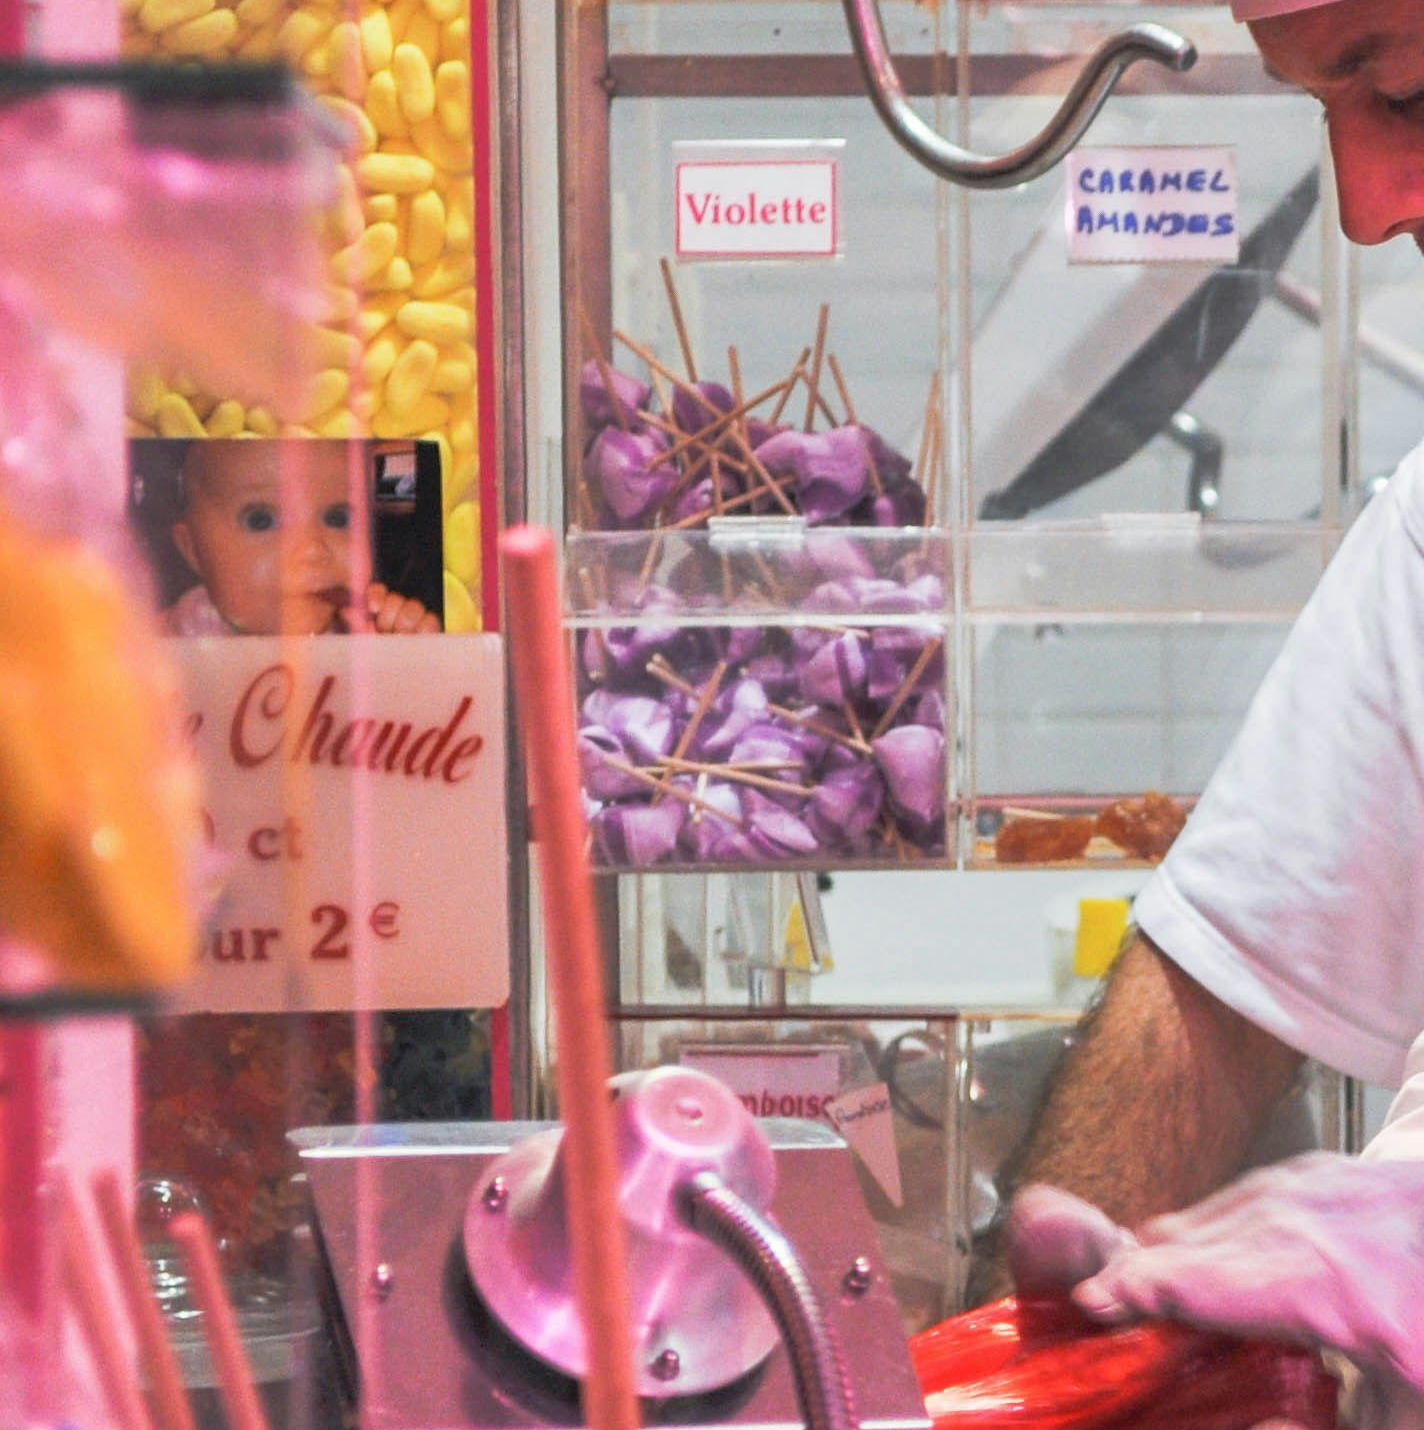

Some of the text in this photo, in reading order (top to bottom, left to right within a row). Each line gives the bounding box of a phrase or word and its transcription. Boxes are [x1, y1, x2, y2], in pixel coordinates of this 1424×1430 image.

[1079, 168, 1230, 193] CARAMEL
[686, 192, 826, 225] Violette
[1077, 205, 1234, 236] AMANDES
[229, 664, 483, 784] Chaude
[203, 927, 280, 962] ur
